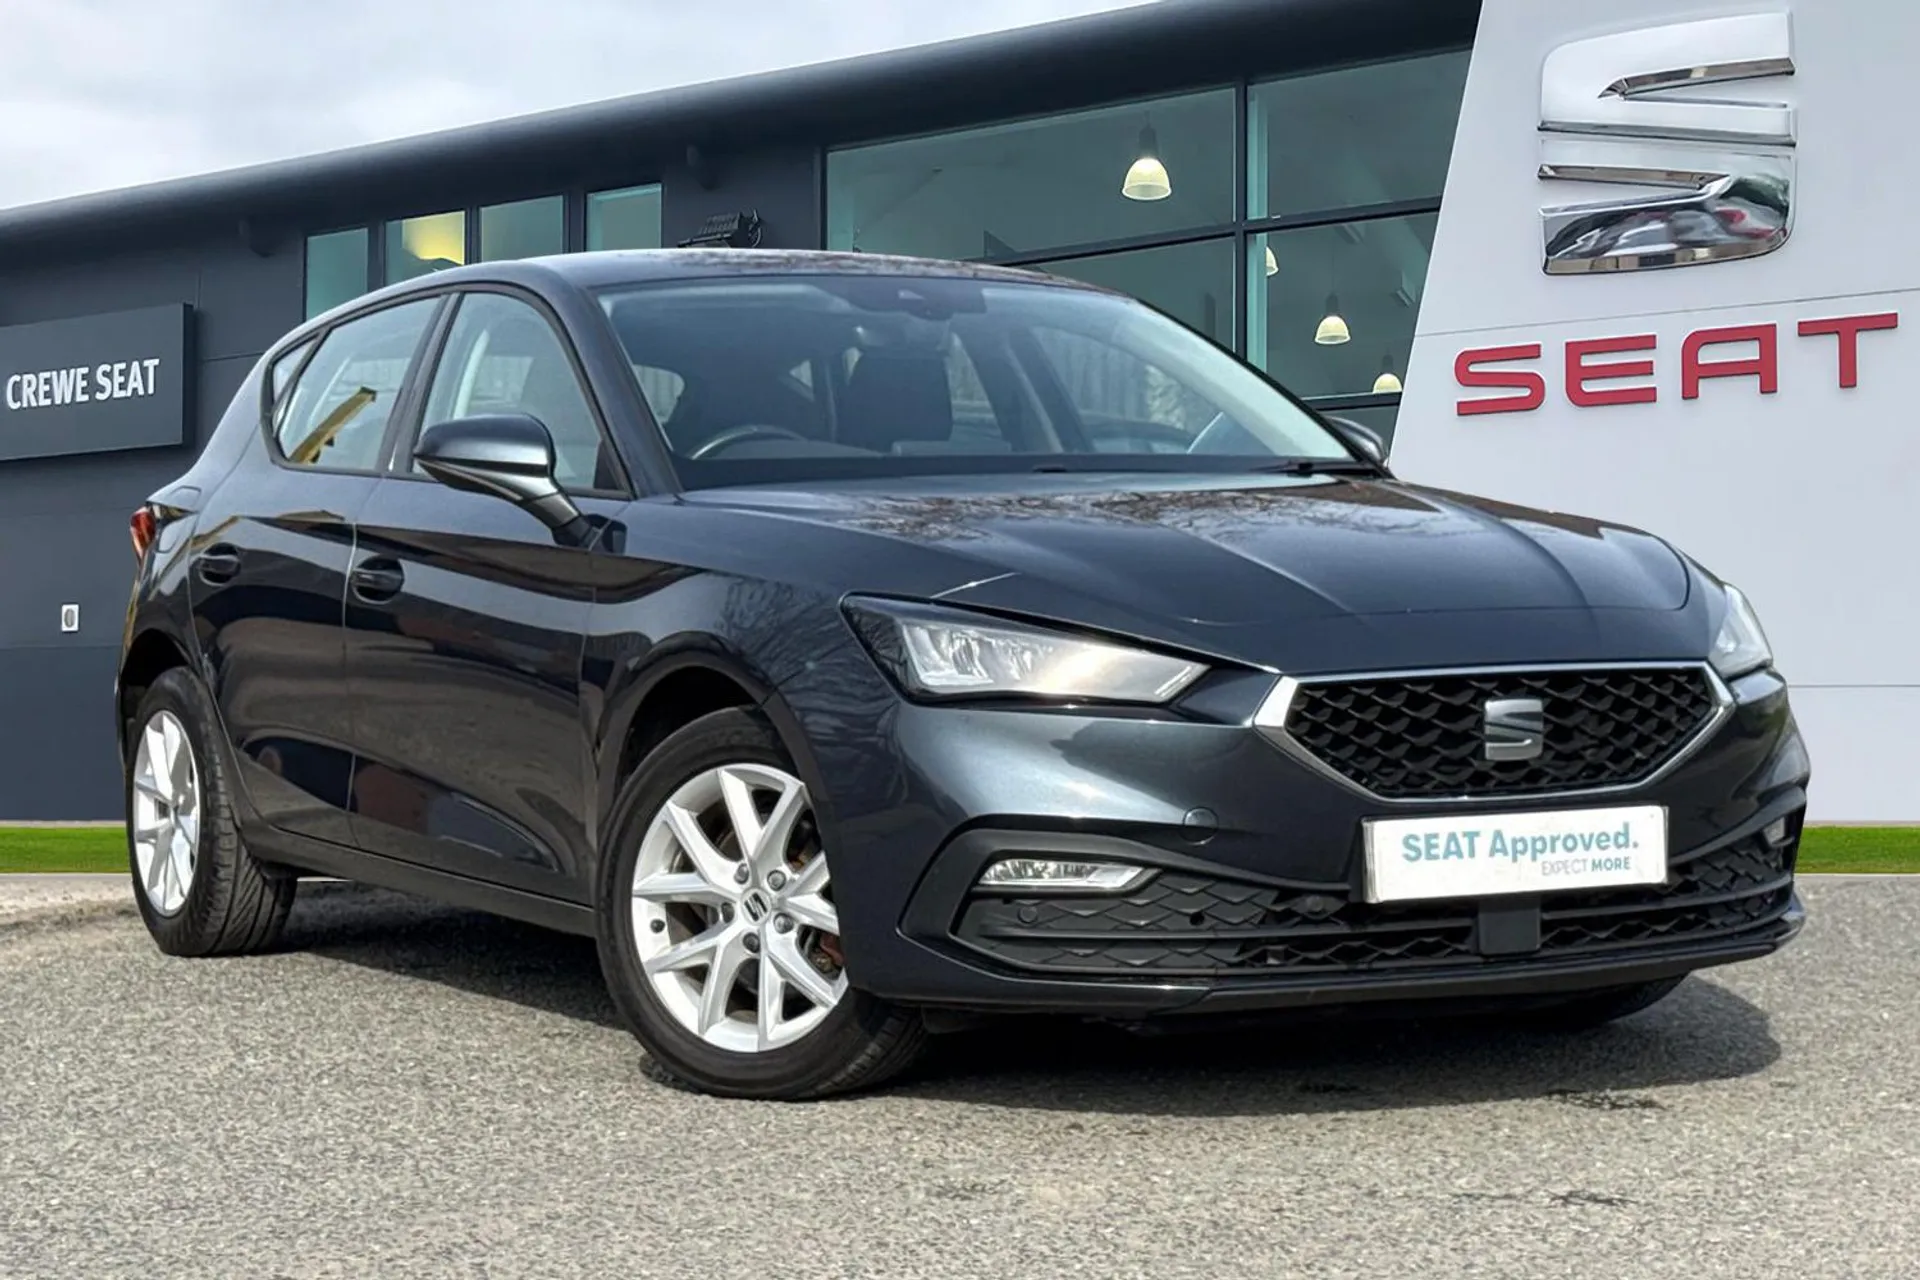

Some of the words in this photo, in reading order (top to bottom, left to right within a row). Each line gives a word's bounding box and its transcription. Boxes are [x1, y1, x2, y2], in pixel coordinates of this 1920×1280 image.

[7, 367, 90, 410] CREWE
[95, 358, 160, 401] SEAT
[1454, 312, 1898, 416] SEAT
[1402, 831, 1480, 863] SEAT
[1488, 822, 1639, 863] Approved.
[1541, 860, 1587, 876] EXPECT
[1590, 856, 1631, 872] MORE
